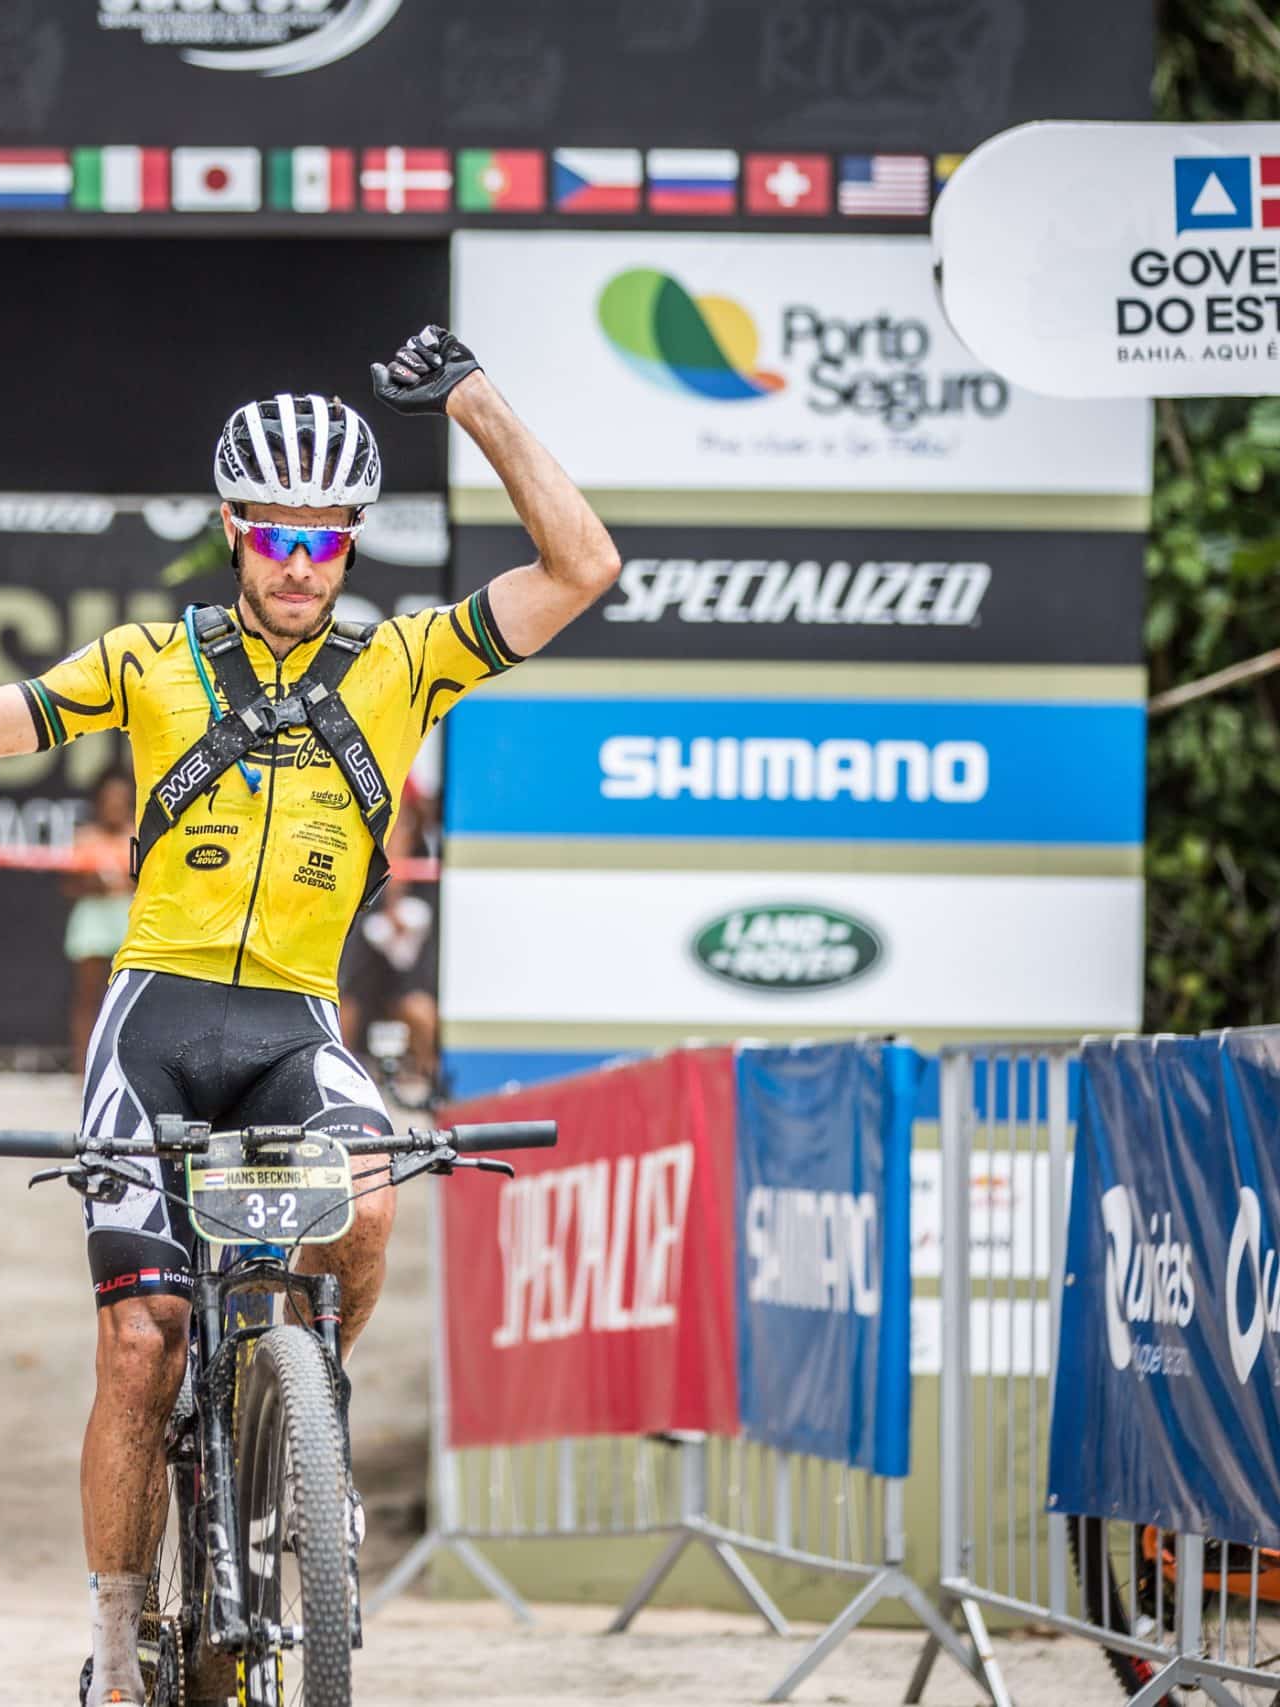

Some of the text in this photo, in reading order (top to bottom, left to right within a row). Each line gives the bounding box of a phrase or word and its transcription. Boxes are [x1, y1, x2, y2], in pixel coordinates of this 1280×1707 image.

[1130, 247, 1280, 288] GOVE
[782, 304, 931, 363] Porto
[1116, 297, 1195, 336] DO
[1202, 343, 1258, 361] AQUI
[807, 352, 1010, 430] Seguro
[602, 558, 992, 627] SPECIALIZED
[599, 736, 990, 803] SHIMANO
[184, 824, 239, 836] SHIMANO
[195, 850, 218, 858] LAND
[196, 856, 223, 865] ROVER
[293, 873, 337, 891] DO ESTADO
[298, 866, 337, 882] GOVERNO
[723, 912, 829, 950] LAND
[732, 943, 860, 981] ROVER
[227, 1171, 301, 1185] HANS BECKING
[247, 1193, 298, 1229] 3-2
